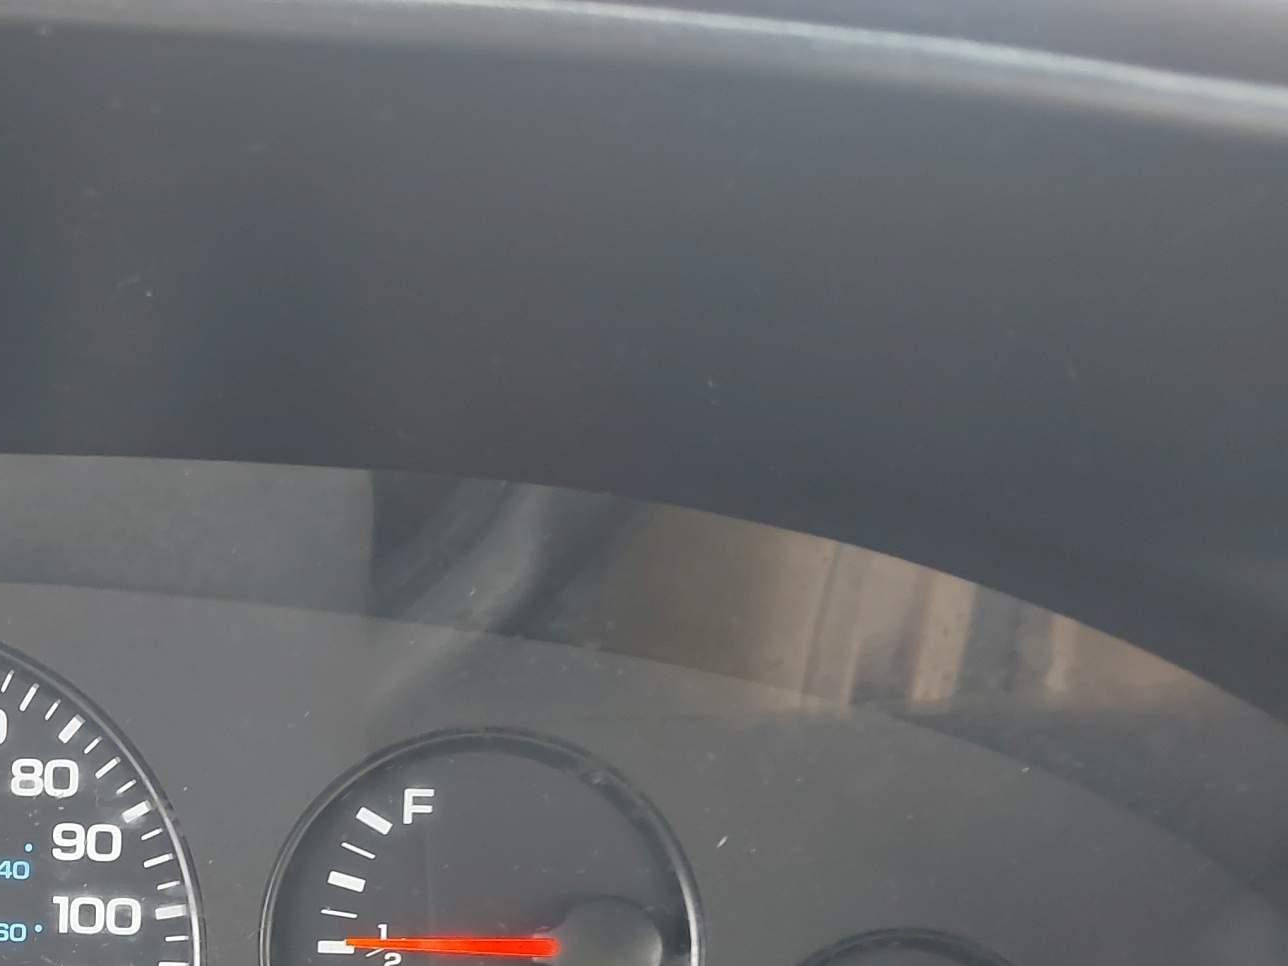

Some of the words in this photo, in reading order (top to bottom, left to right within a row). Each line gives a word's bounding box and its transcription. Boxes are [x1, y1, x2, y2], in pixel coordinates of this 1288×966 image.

[10, 759, 78, 797] 80
[403, 789, 435, 825] F
[52, 824, 121, 862] 90
[53, 896, 141, 936] 100
